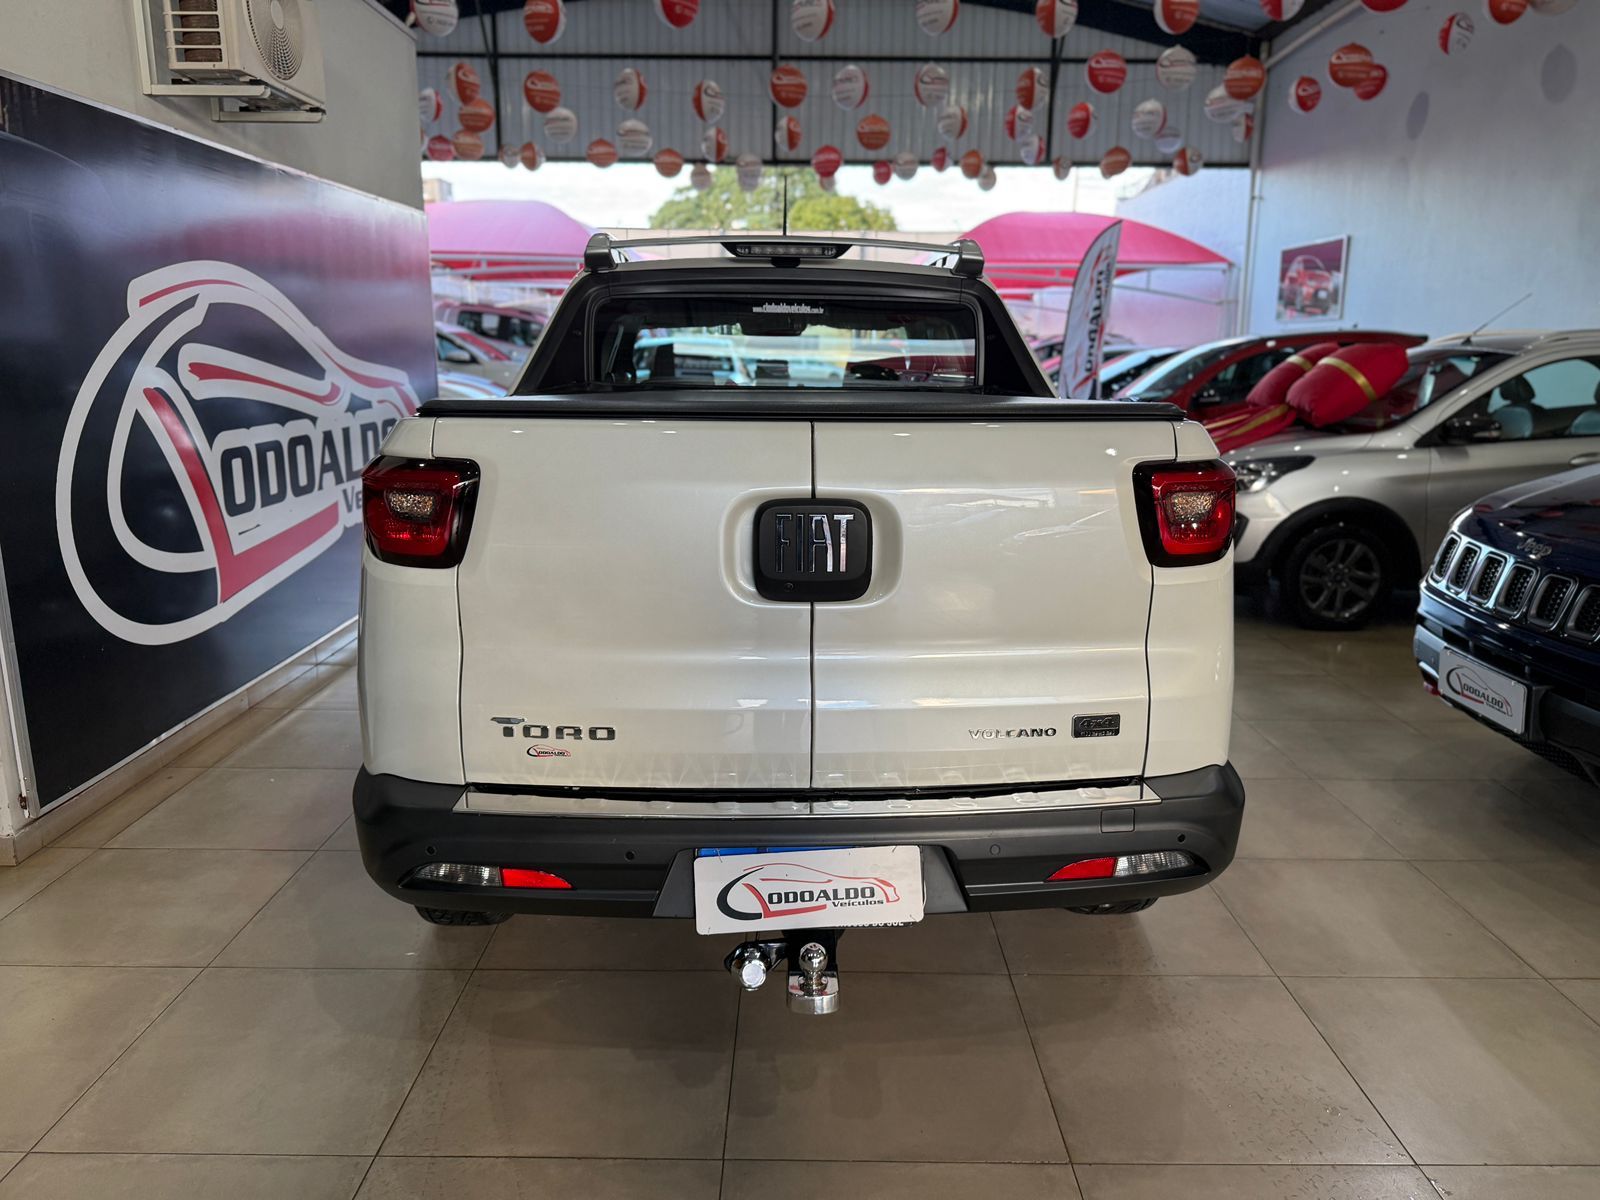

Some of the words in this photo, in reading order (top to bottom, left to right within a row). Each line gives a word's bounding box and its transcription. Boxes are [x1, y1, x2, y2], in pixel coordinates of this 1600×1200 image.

[775, 513, 855, 573] FIAT
[1516, 537, 1553, 560] Jeep
[490, 716, 616, 741] TORO
[968, 727, 1057, 740] VOLCANO
[832, 898, 885, 909] Veículos
